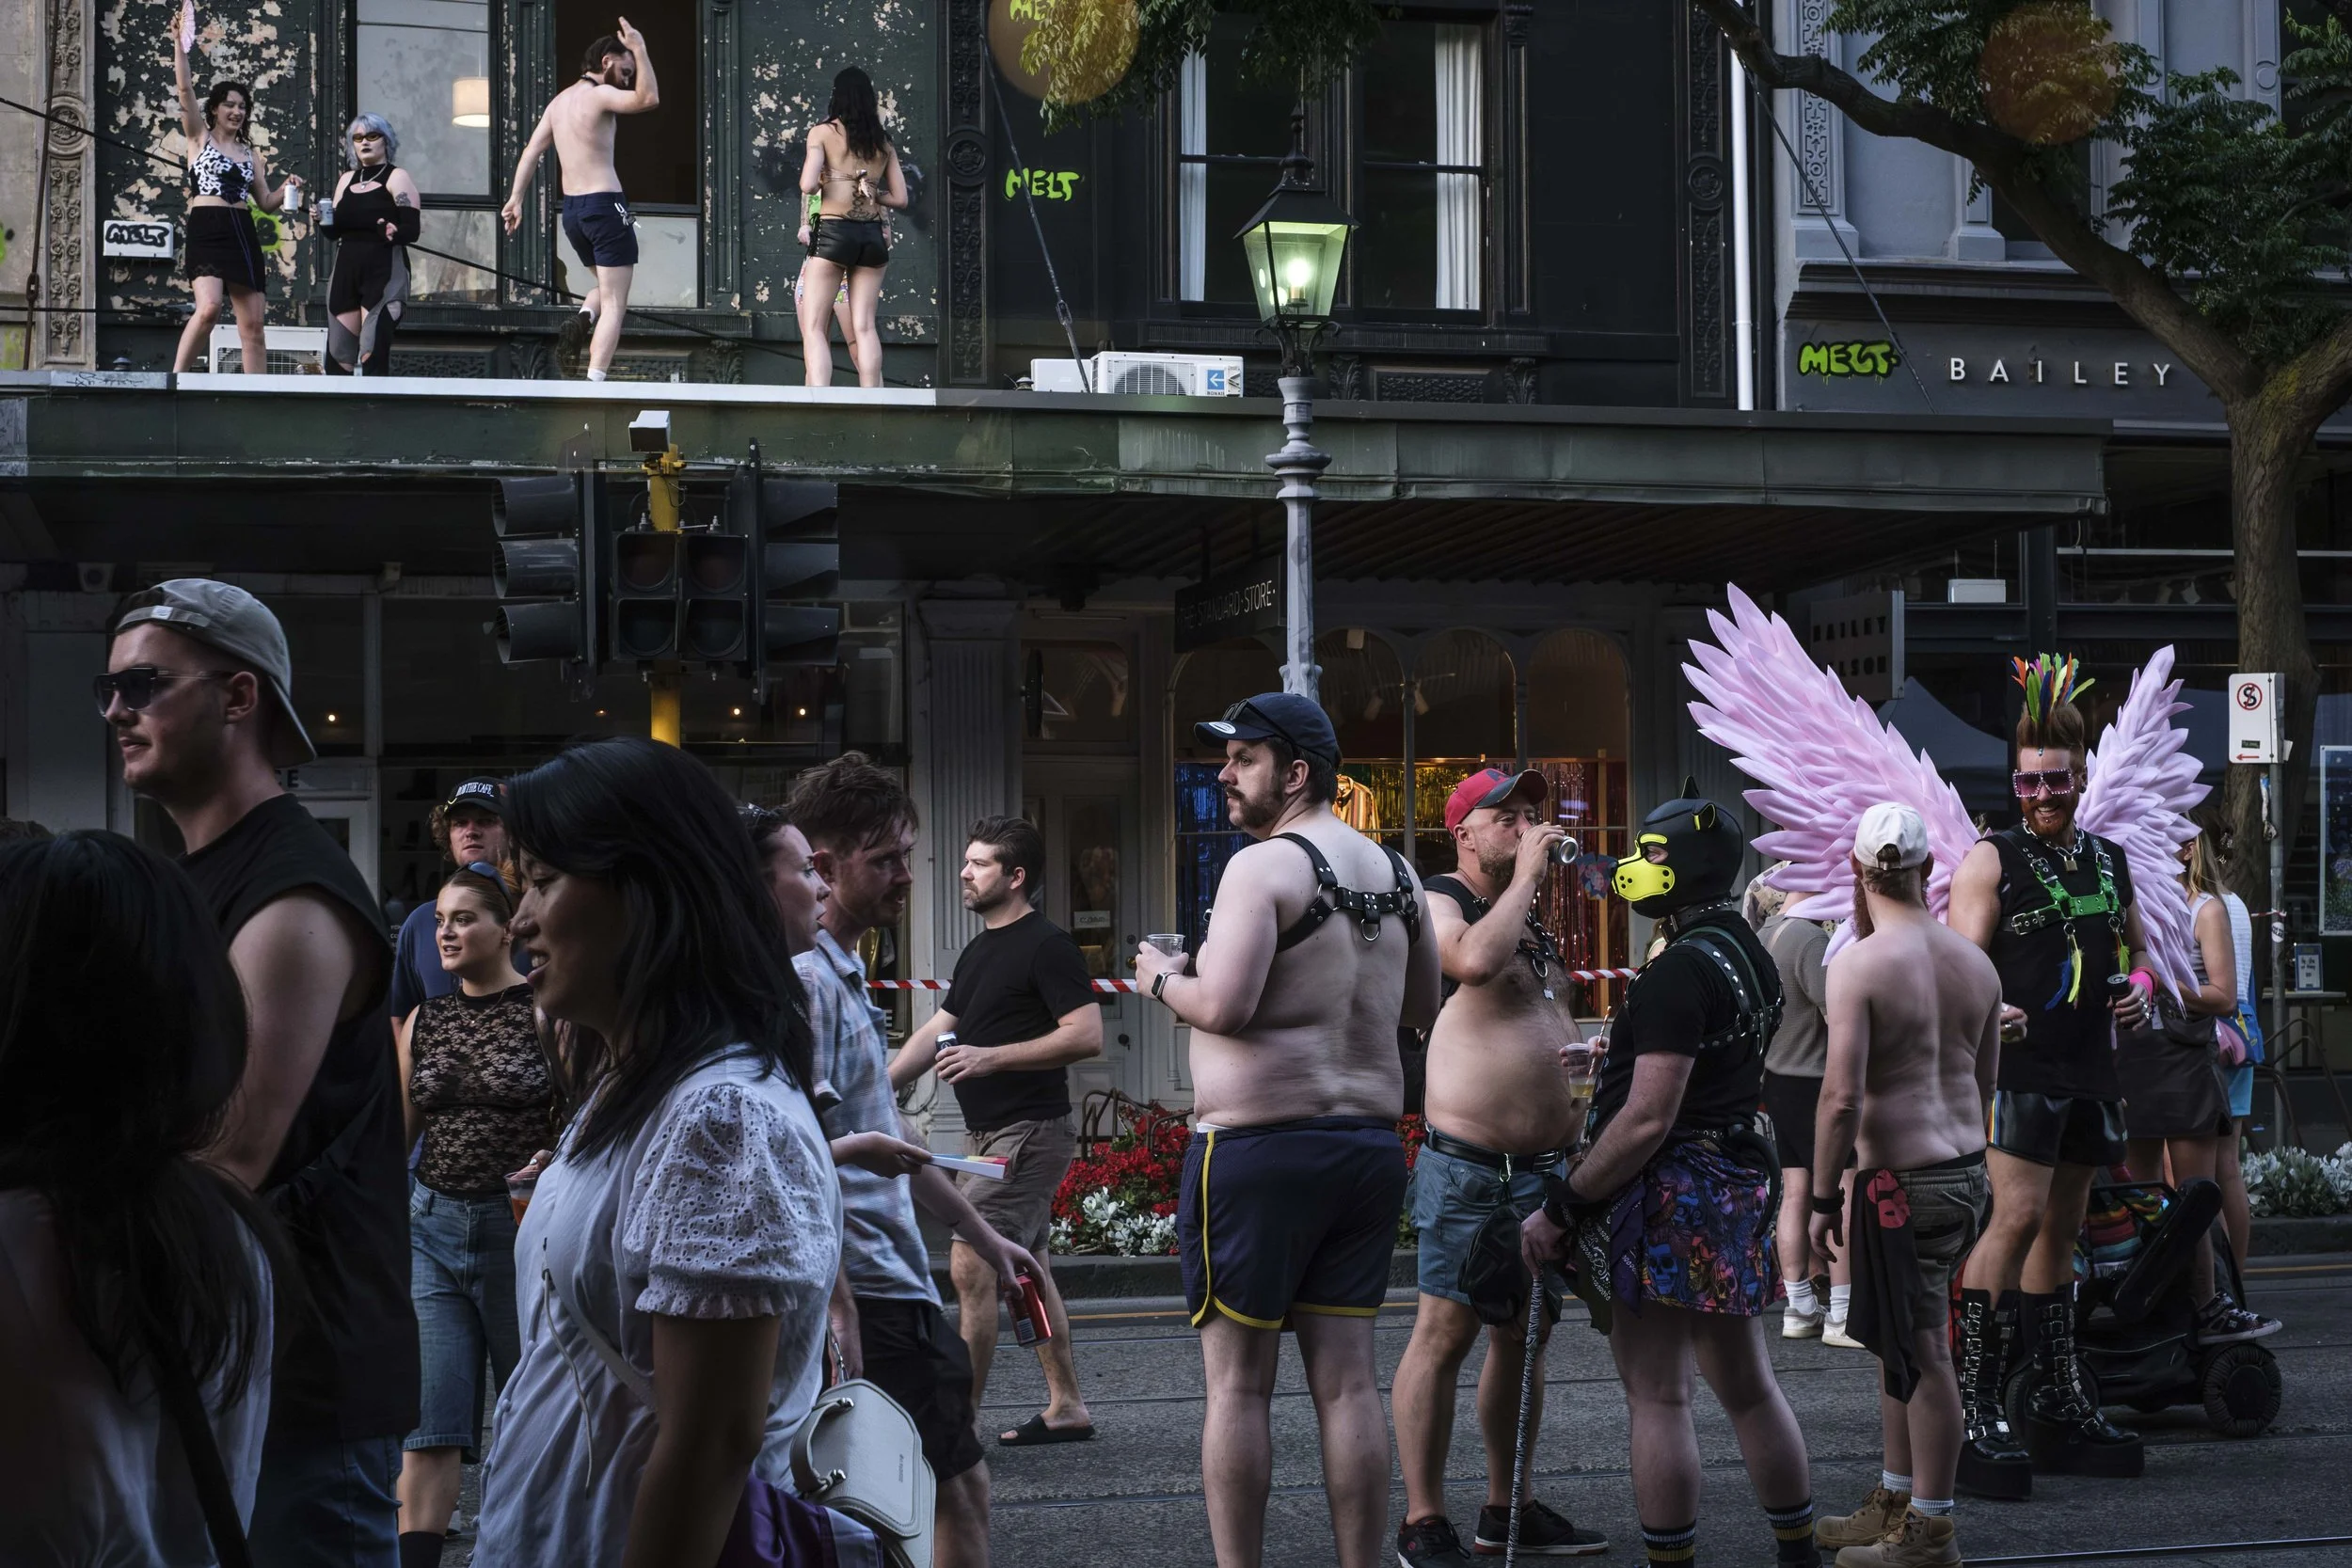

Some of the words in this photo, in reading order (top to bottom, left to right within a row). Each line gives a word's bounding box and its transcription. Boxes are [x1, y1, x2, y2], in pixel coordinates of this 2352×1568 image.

[1009, 0, 1055, 22] ME
[1005, 167, 1080, 201] MELT
[1949, 357, 2170, 387] BAILEY
[1198, 591, 1241, 627] STANDARD
[1244, 579, 1273, 613] STORE
[1812, 616, 1887, 642] BAILEY
